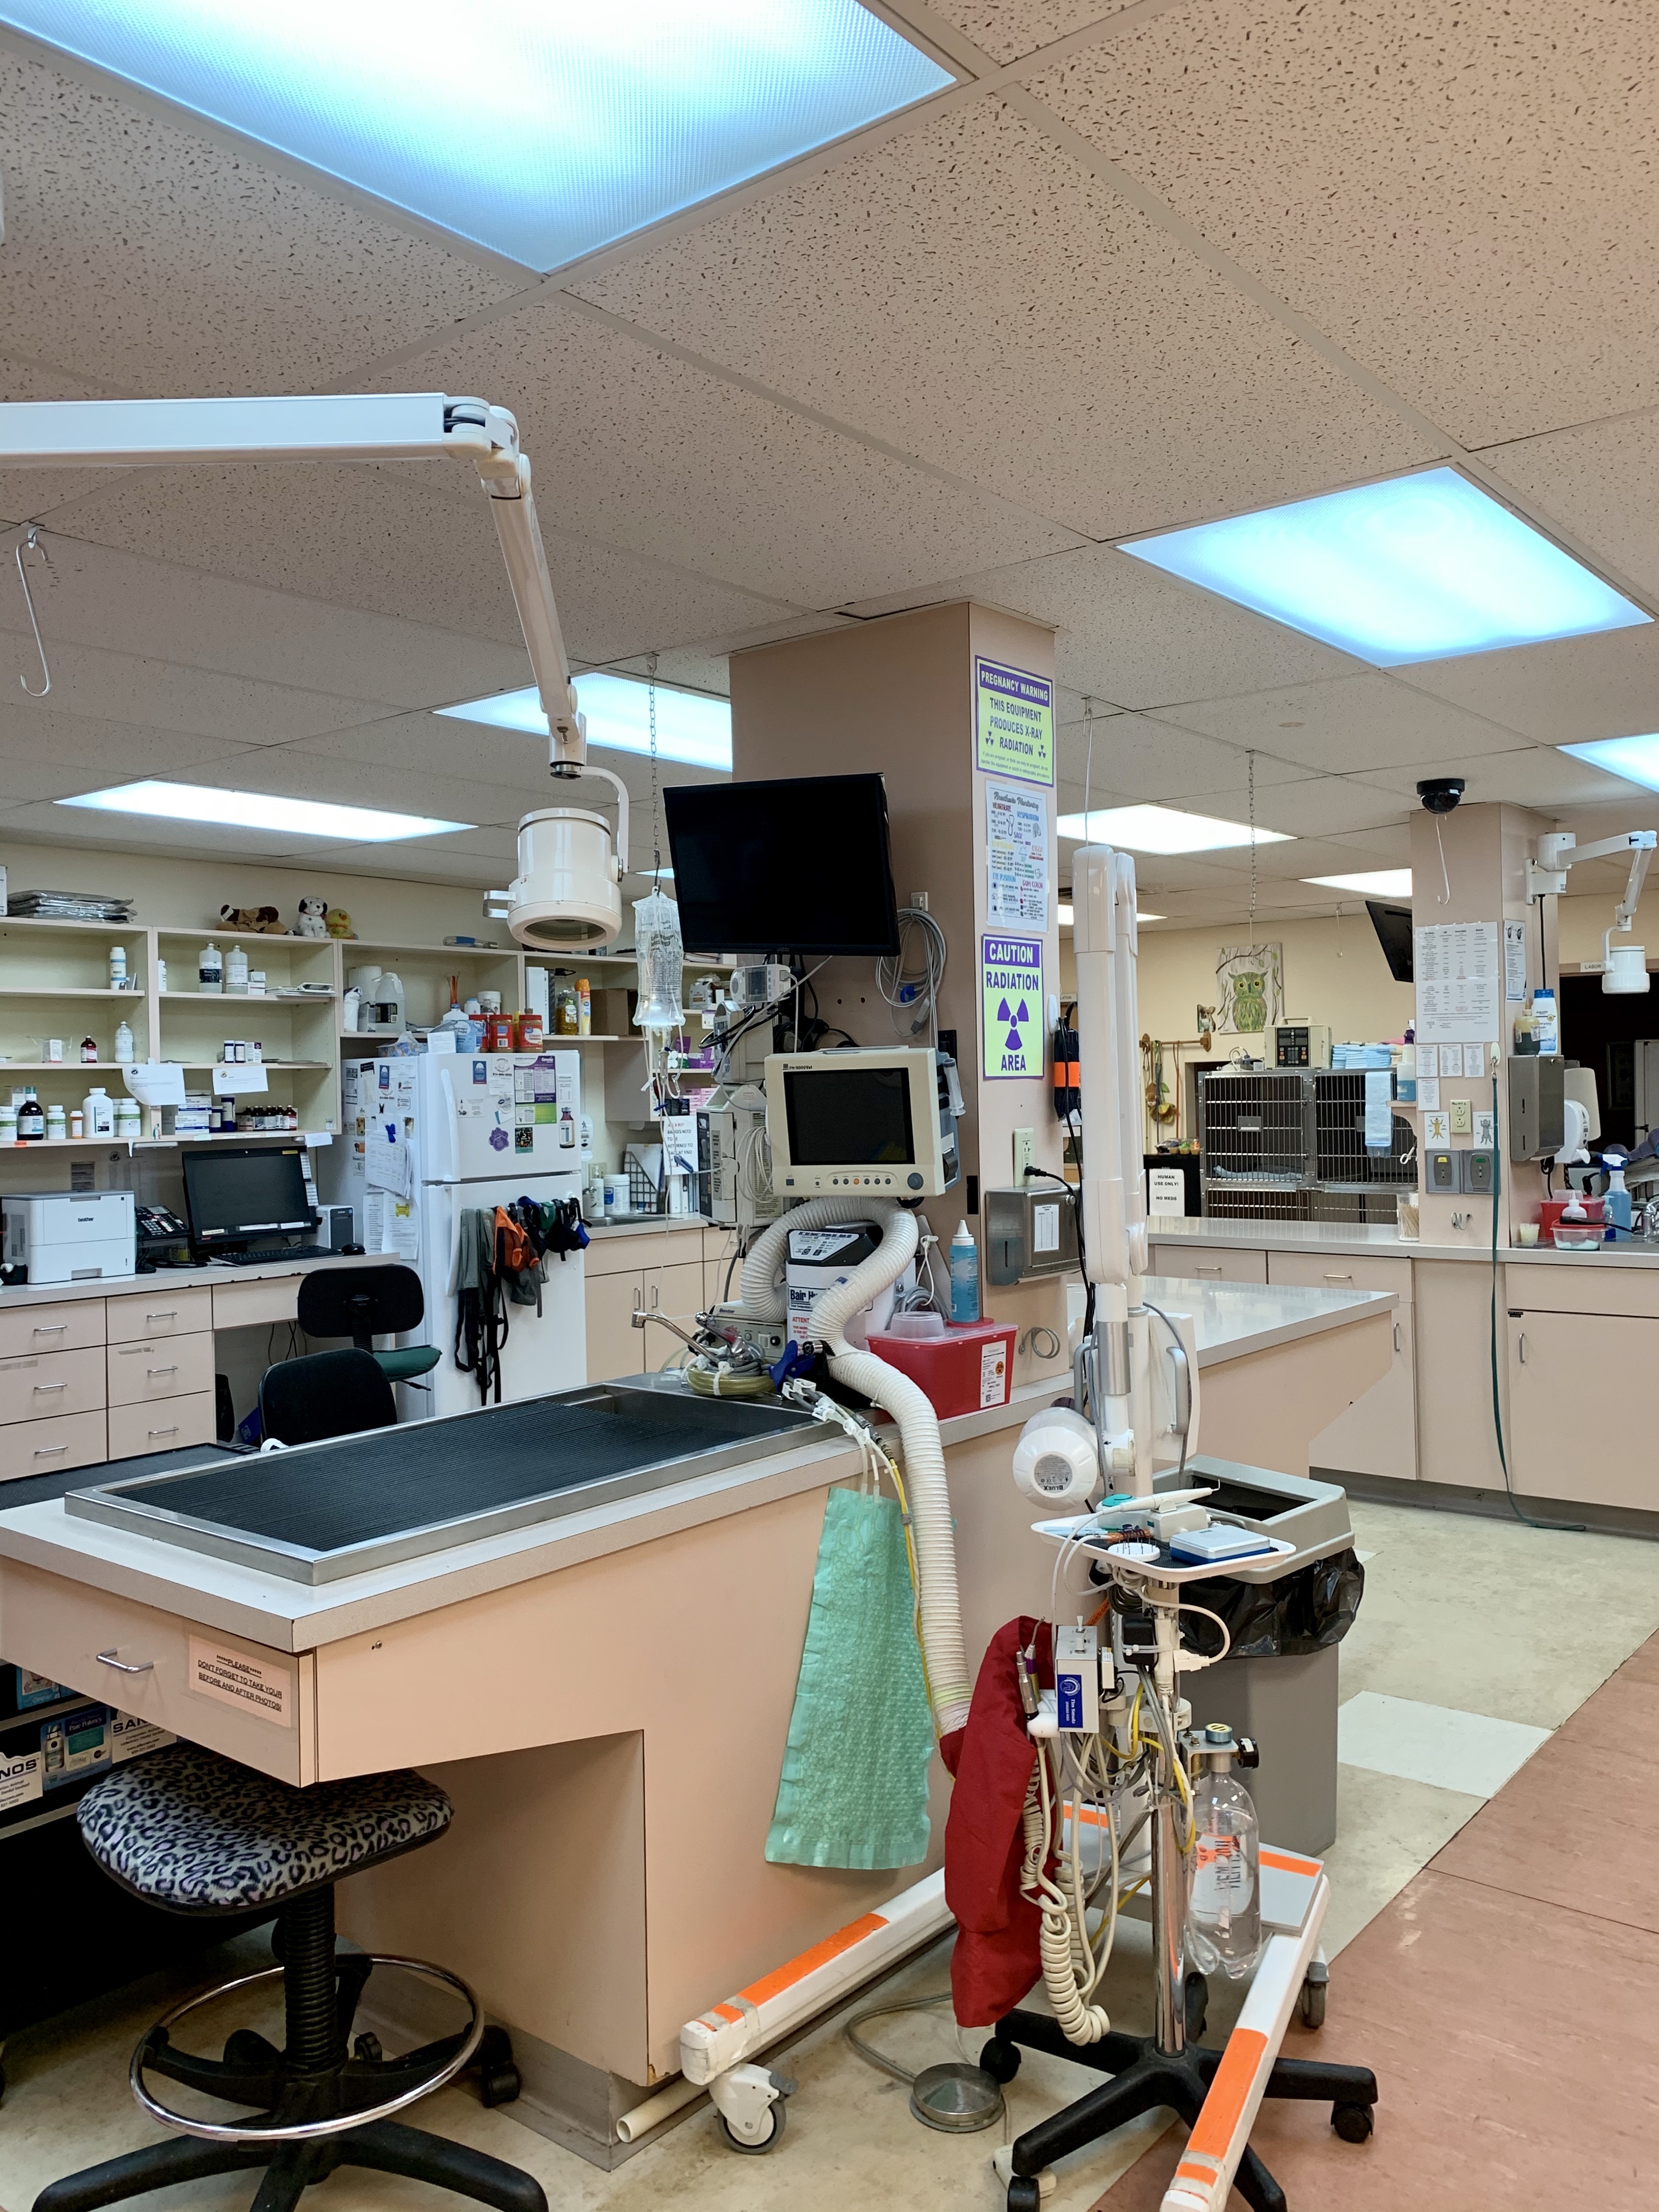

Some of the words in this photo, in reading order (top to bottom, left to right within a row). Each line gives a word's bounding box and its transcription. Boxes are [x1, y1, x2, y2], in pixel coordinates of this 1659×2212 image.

[981, 670, 1019, 692] PREGNANCY
[1020, 683, 1048, 701] WARNING
[990, 697, 1005, 712] THIS
[1006, 703, 1042, 722] EQUIPMENT
[990, 715, 1024, 735] PRODUCES
[1025, 725, 1043, 740] X-RAY
[1000, 737, 1033, 756] RADIATION
[990, 943, 1033, 963] CAUTION
[986, 971, 1039, 991] RADIATION
[1001, 1054, 1026, 1071] AREA
[790, 1289, 806, 1301] Bair
[199, 1672, 221, 1687] BEFORE
[222, 1682, 234, 1692] AND
[236, 1687, 254, 1700] AFTER
[255, 1695, 282, 1712] PHOTOS!
[216, 1666, 239, 1681] FORGET
[240, 1675, 247, 1685] TO
[249, 1679, 264, 1691] TAKE
[265, 1685, 282, 1699] YOUR
[113, 1718, 148, 1733] SAN
